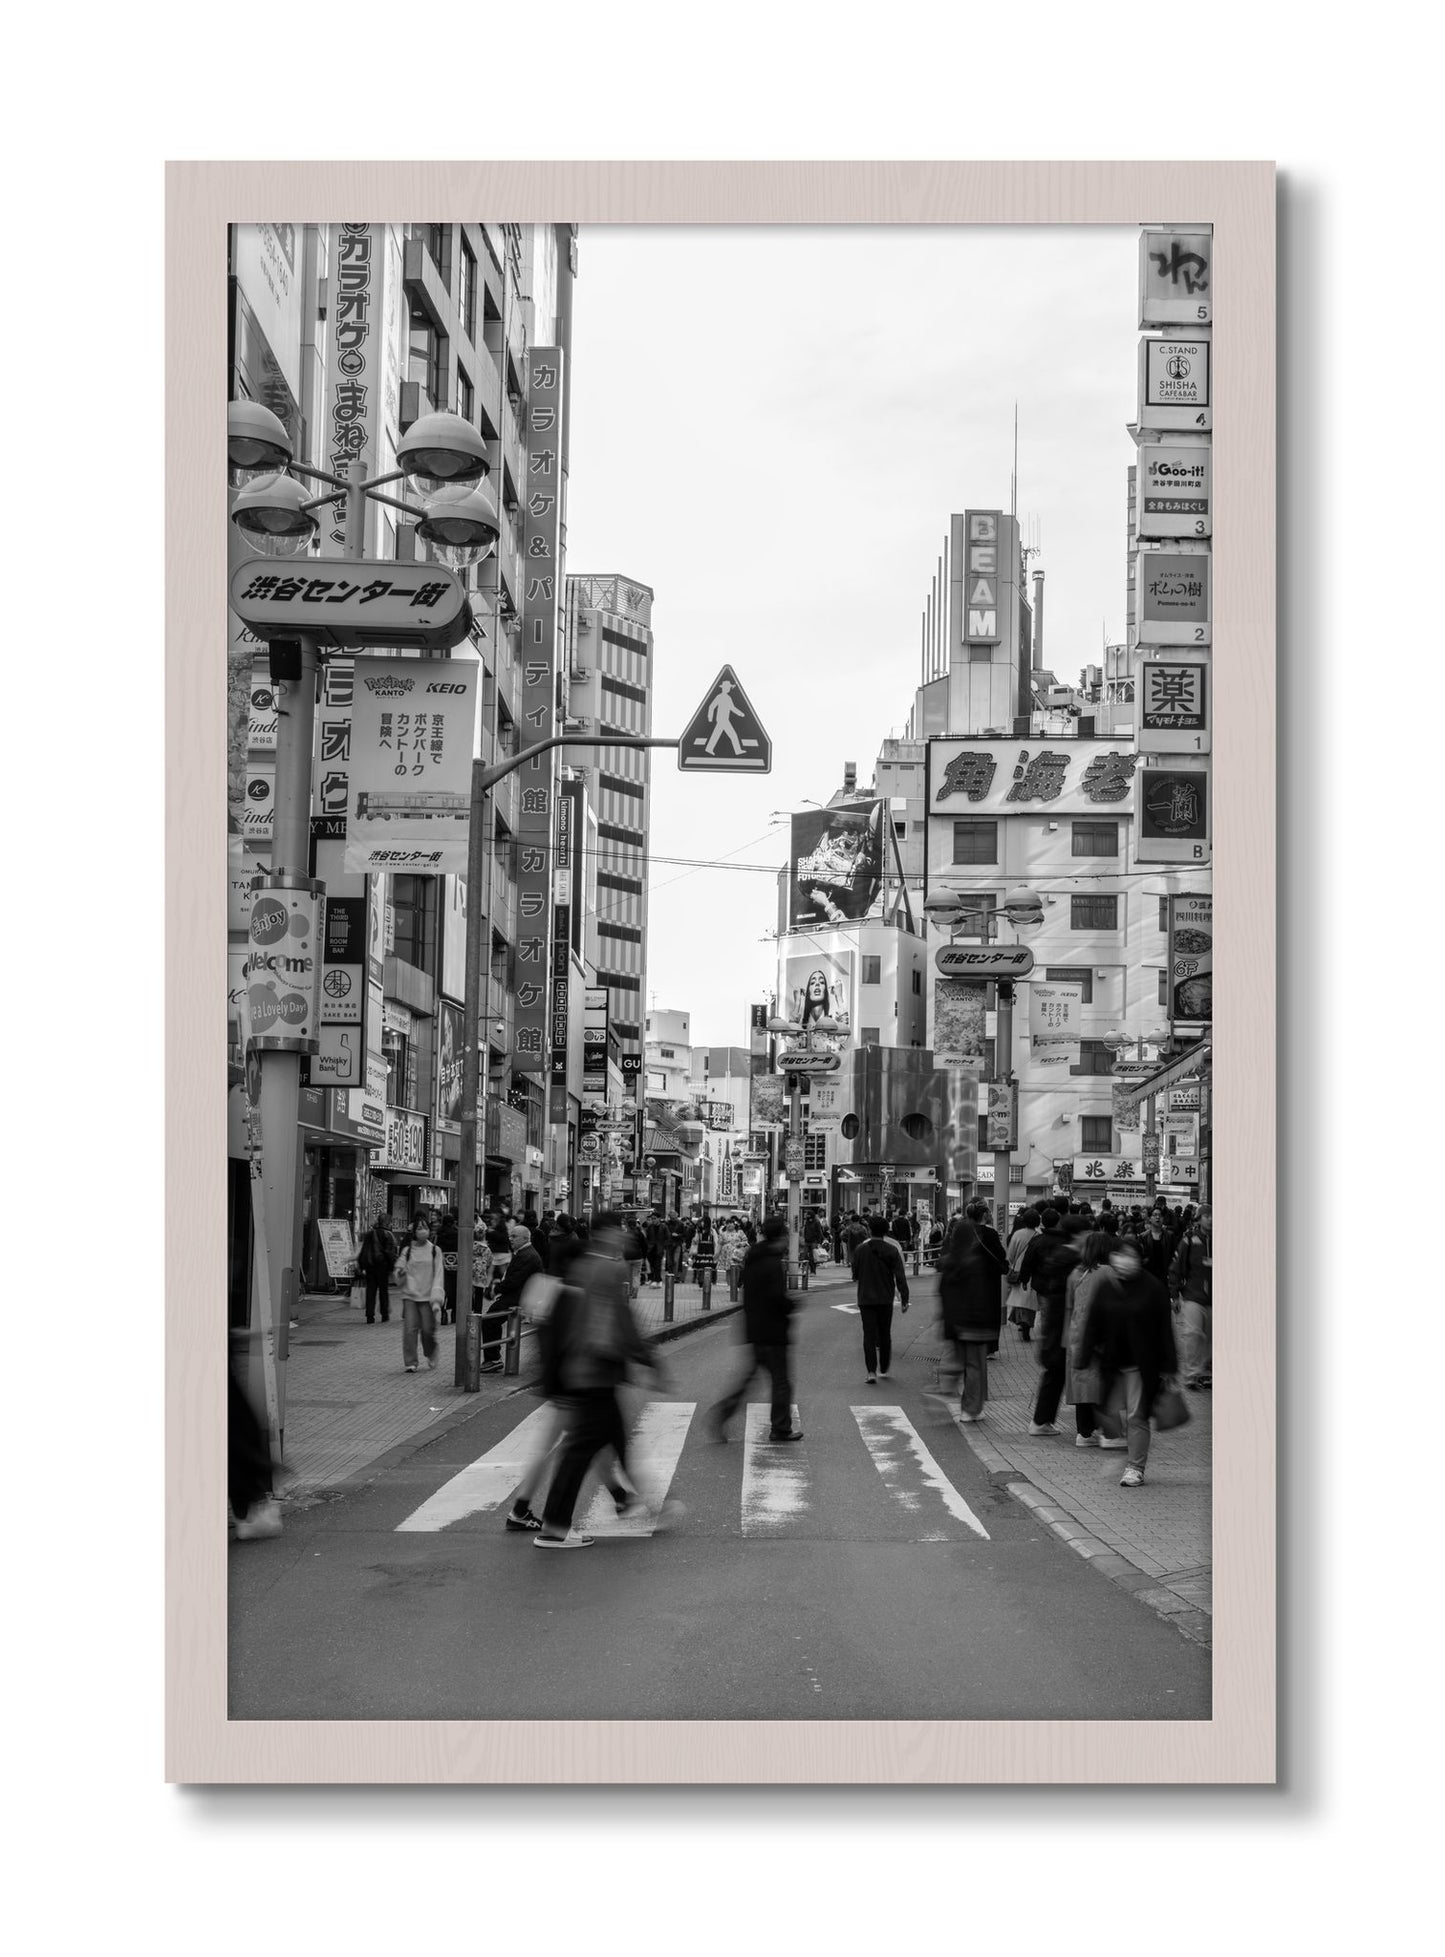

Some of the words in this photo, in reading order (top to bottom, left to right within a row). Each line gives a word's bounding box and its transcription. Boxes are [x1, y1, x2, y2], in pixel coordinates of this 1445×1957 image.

[336, 235, 372, 351] カラオケ
[1196, 307, 1207, 320] 5
[1159, 346, 1198, 354] C.STAND
[1159, 380, 1197, 390] SHISHA
[1158, 463, 1204, 477] Goo-it!
[1148, 501, 1205, 511] 全身もみほぐし
[1195, 520, 1205, 534] 3
[968, 514, 997, 637] BEAM
[240, 574, 452, 608] 渋谷センター街
[1194, 628, 1205, 641] 2
[426, 682, 468, 695] KEIO
[1152, 668, 1195, 713] 薬
[378, 713, 393, 750] 冒険へ
[394, 714, 410, 777] カントーの
[430, 714, 445, 764] 京王線で
[1194, 736, 1201, 750] 1
[935, 751, 1138, 802] 角海老
[560, 801, 568, 832] kimono
[367, 850, 443, 863] 渋谷センター街
[559, 835, 567, 866] hearts
[1193, 845, 1203, 858] B
[252, 909, 288, 939] Enjoy
[517, 848, 545, 1054] カラオケ館
[248, 951, 314, 973] Welcome
[941, 953, 1027, 965] 渋谷センター街
[1174, 961, 1199, 977] 6F
[319, 1057, 347, 1067] Whisky
[623, 1059, 641, 1069] GU
[779, 1056, 832, 1065] 渋谷センター街
[318, 1065, 337, 1073] Bank
